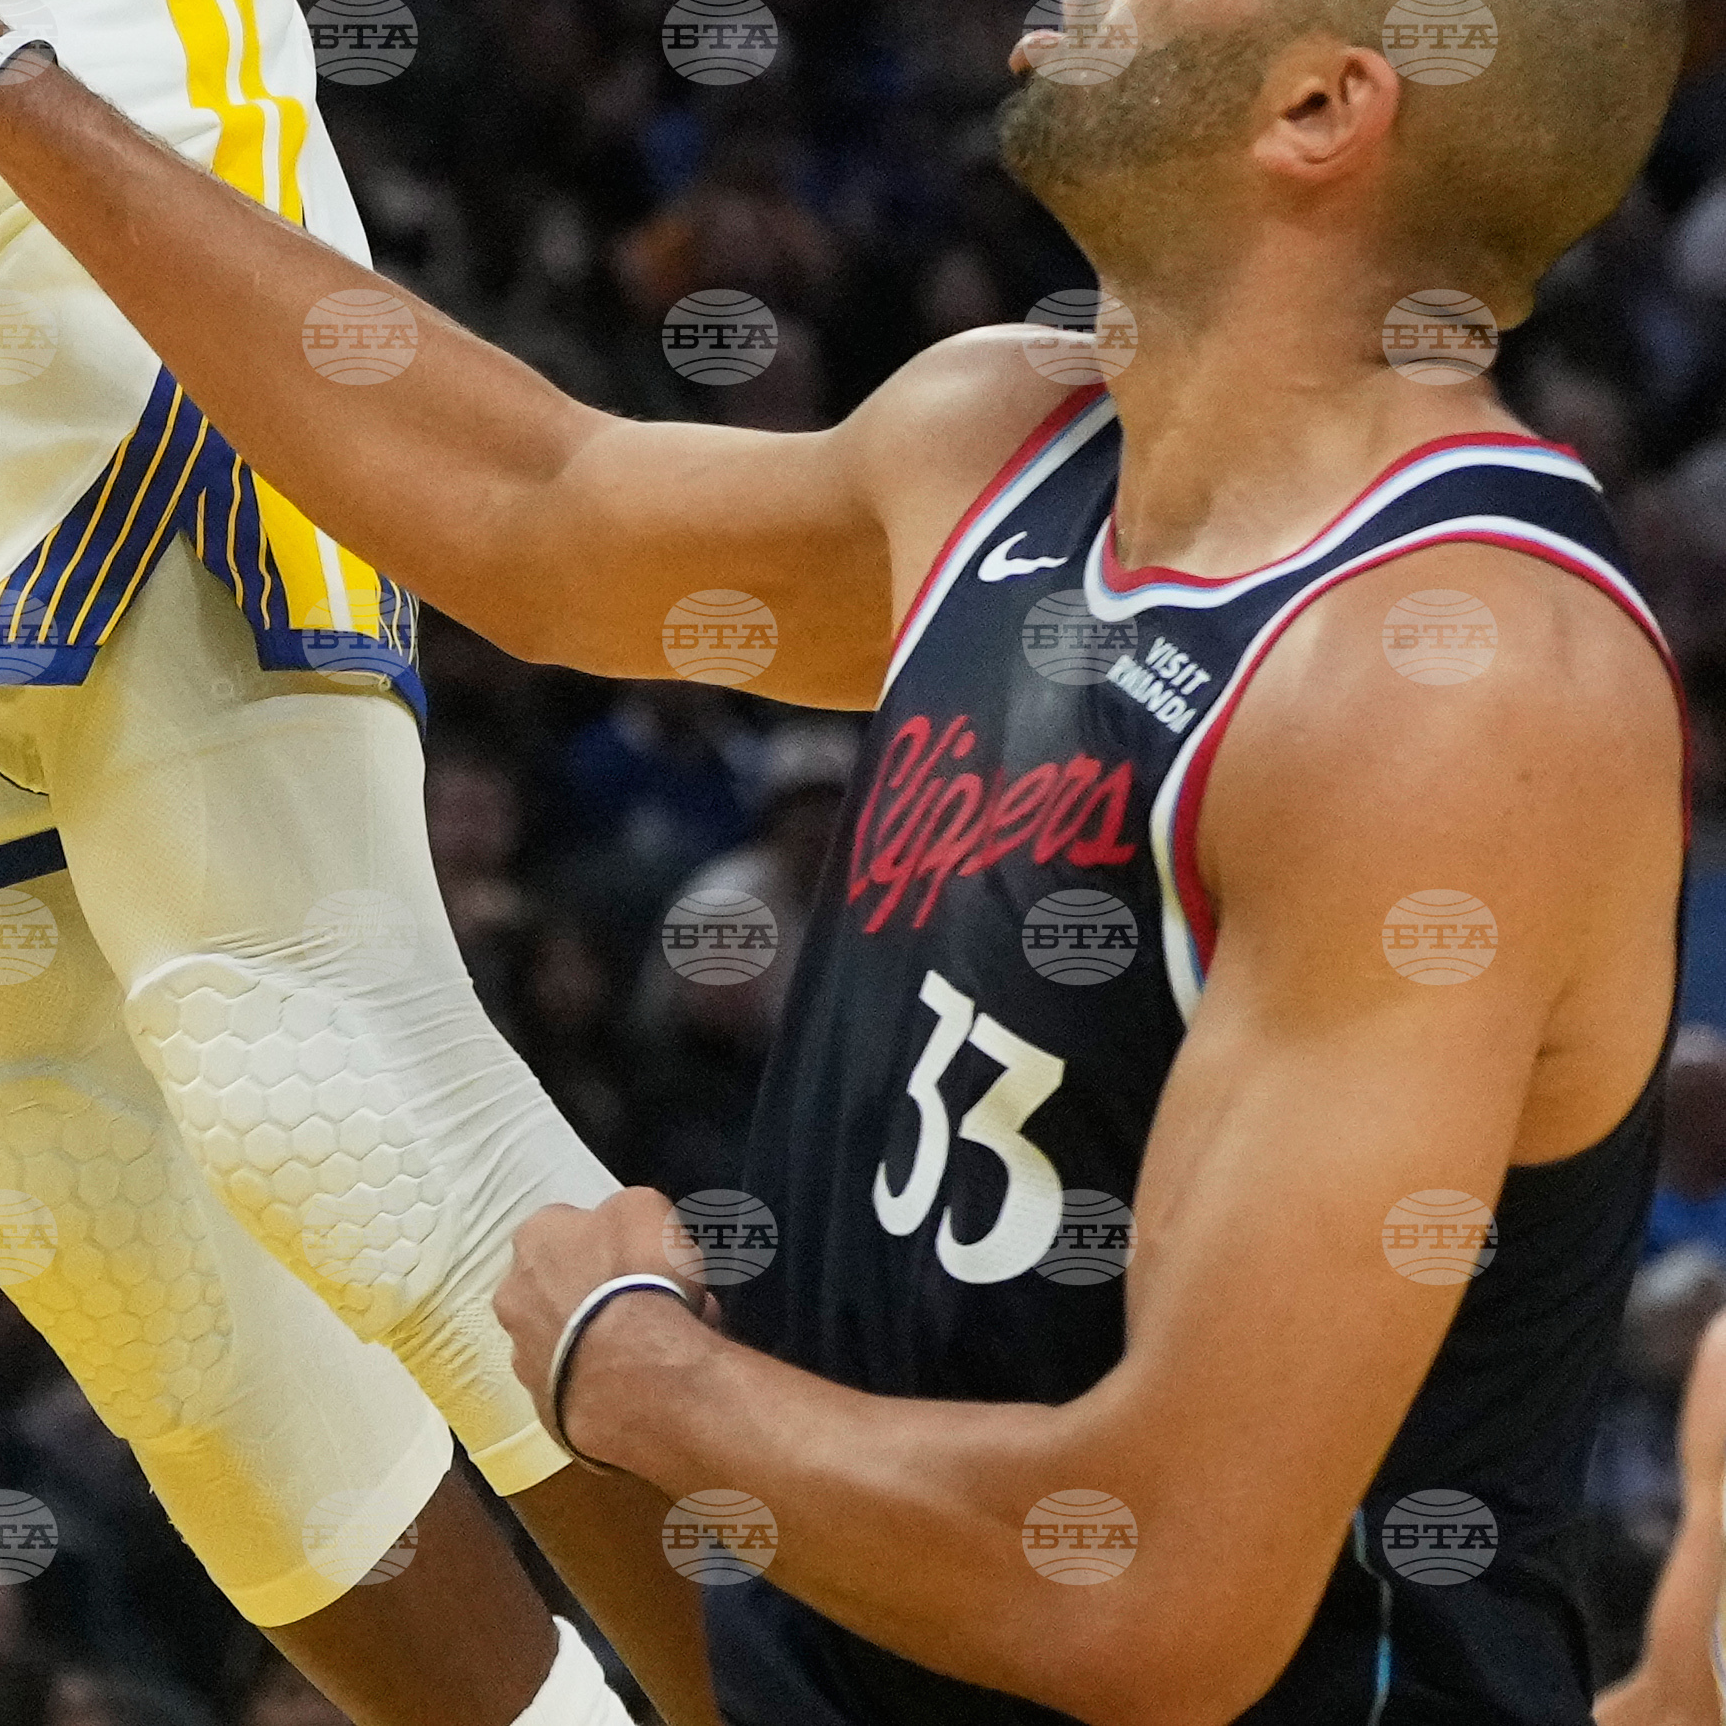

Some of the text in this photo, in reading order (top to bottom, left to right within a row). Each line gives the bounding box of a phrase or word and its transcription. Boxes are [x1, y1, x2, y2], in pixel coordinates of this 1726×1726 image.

[1145, 636, 1212, 695] VISIT
[847, 714, 1137, 935] Clippers
[872, 969, 1066, 1285] 33
